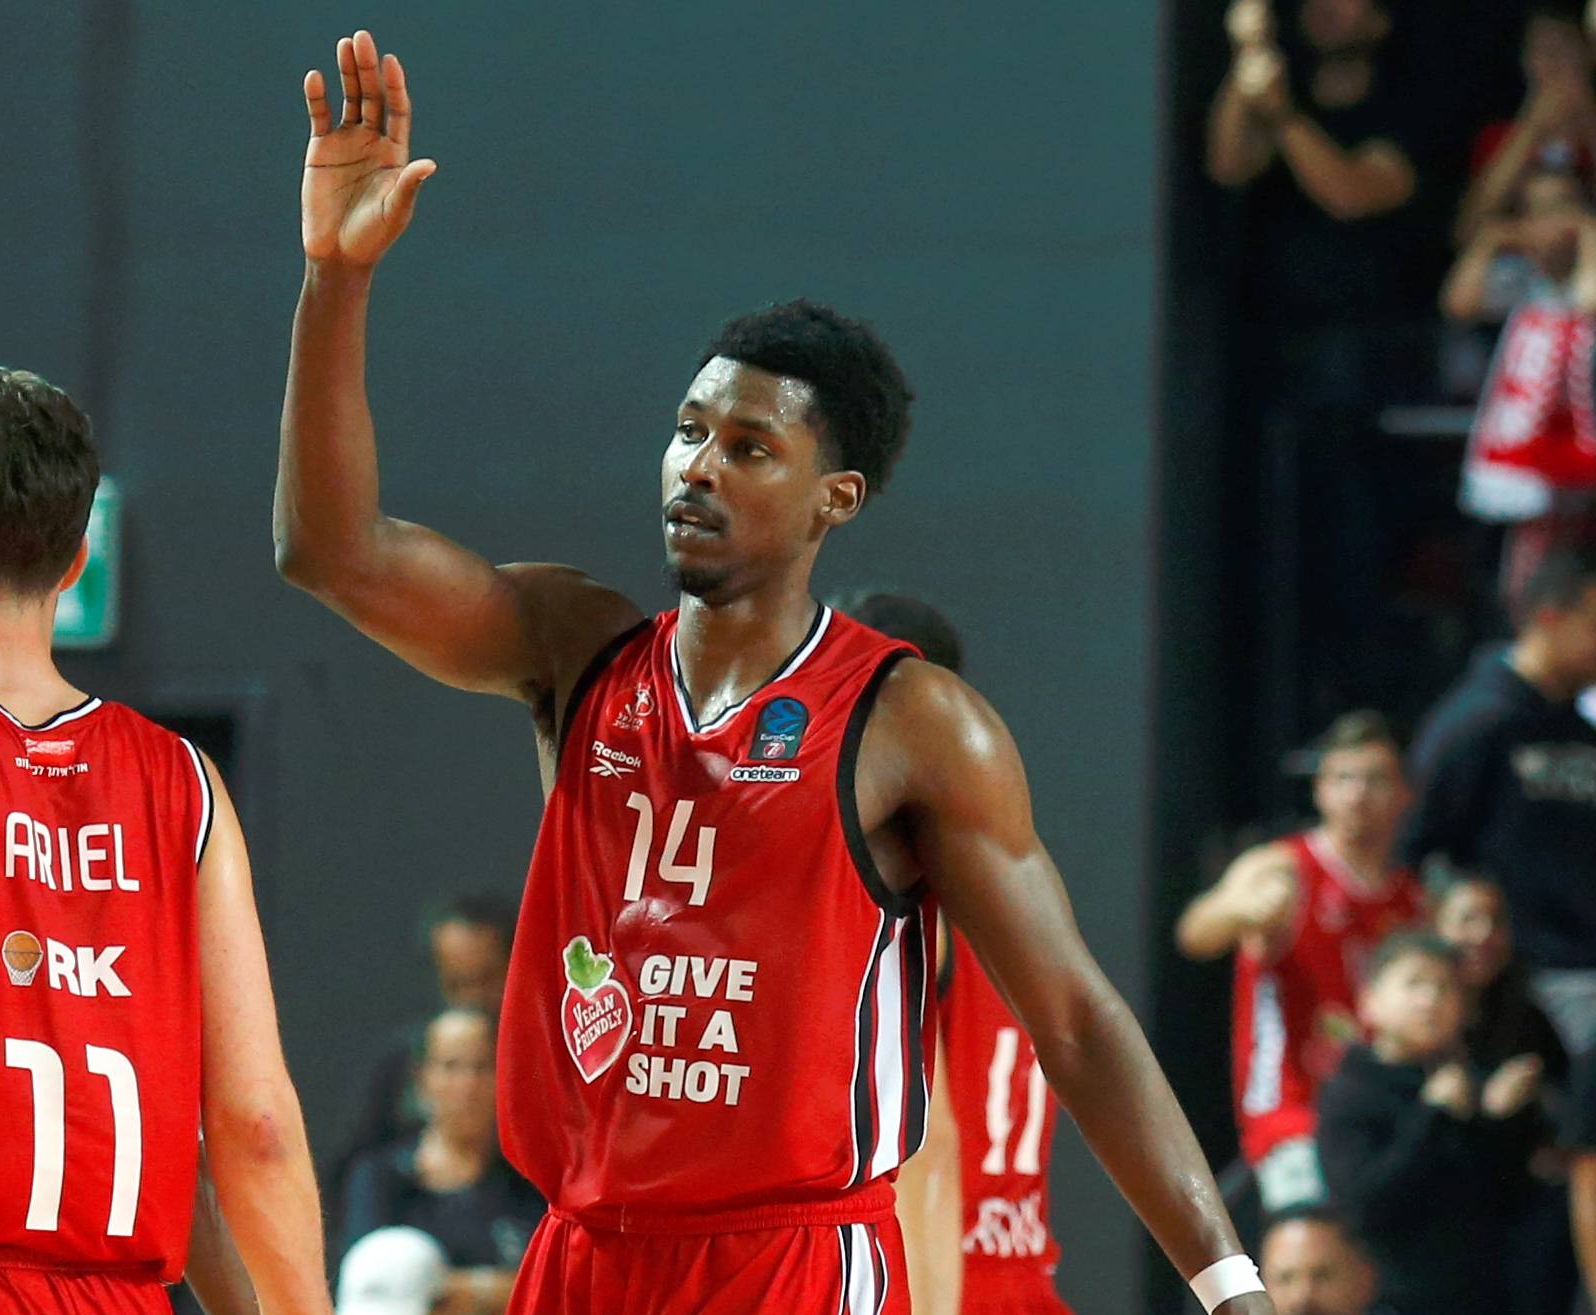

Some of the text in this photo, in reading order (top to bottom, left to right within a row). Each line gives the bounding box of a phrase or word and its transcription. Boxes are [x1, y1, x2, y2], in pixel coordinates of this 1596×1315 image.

[591, 740, 642, 768] Reebok
[732, 766, 798, 780] oneteam
[4, 811, 141, 893] ARIEL
[622, 790, 718, 907] 14
[639, 953, 758, 1002] GIVE
[572, 993, 615, 1029] VEGAN
[572, 1008, 623, 1057] FRIENDLY
[639, 1004, 739, 1055] IT A
[626, 1052, 751, 1107] SHOT
[4, 1037, 143, 1238] 11
